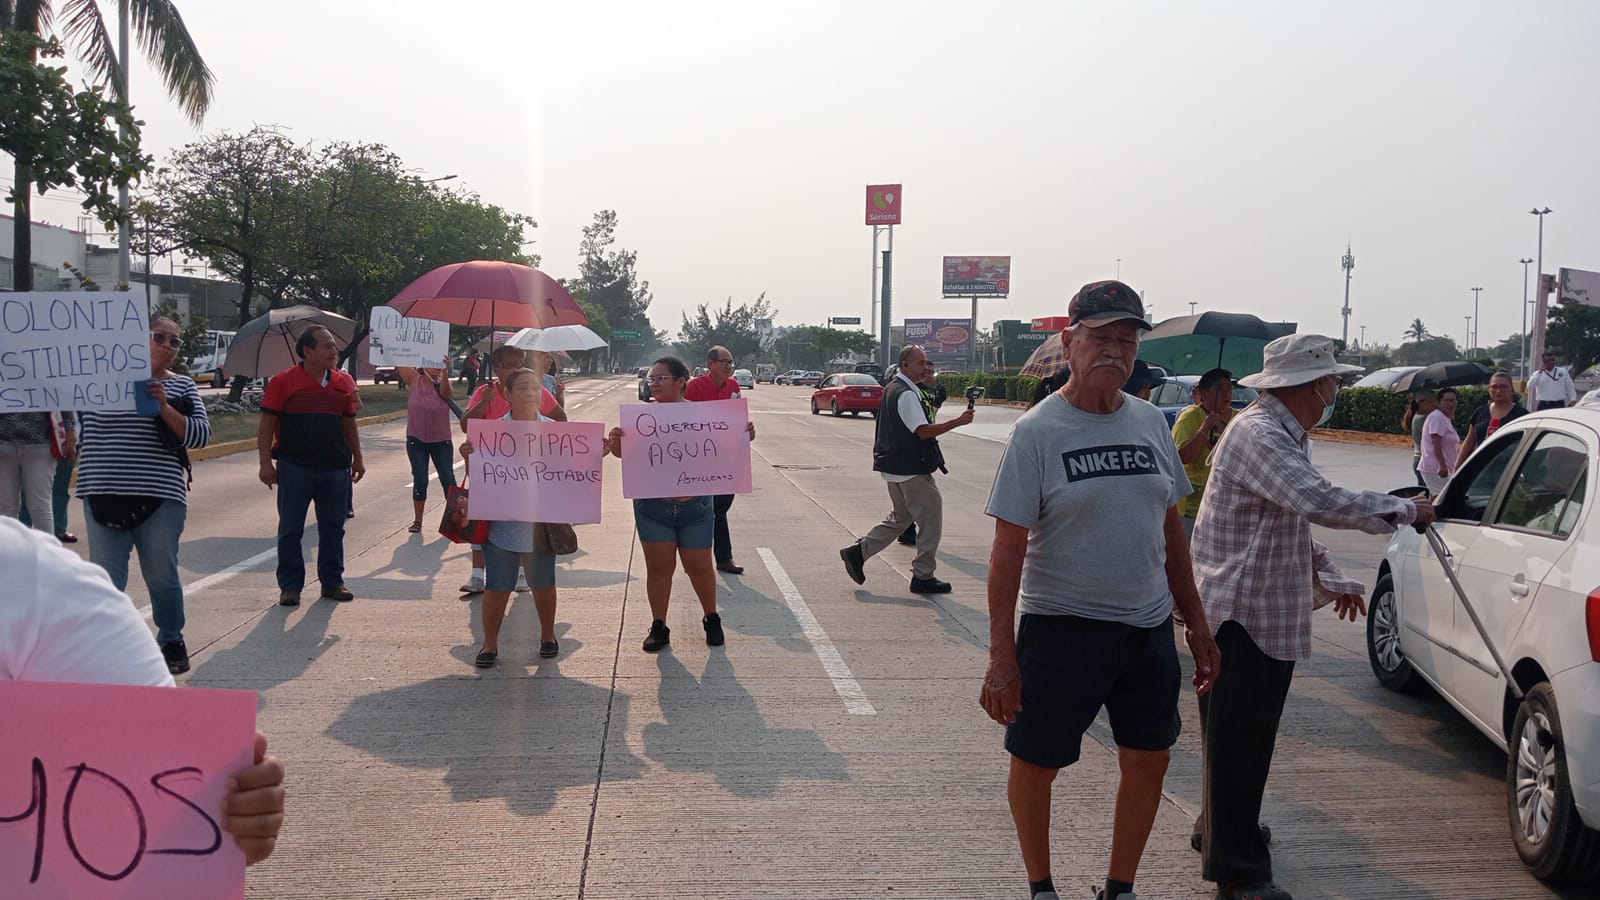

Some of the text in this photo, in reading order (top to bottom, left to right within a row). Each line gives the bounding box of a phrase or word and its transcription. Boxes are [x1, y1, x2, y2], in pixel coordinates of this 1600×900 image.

[0, 380, 135, 409] SIN AGUA
[478, 431, 590, 458] NO PIPAS
[648, 438, 718, 468] AGUA
[483, 461, 529, 484] AGUA
